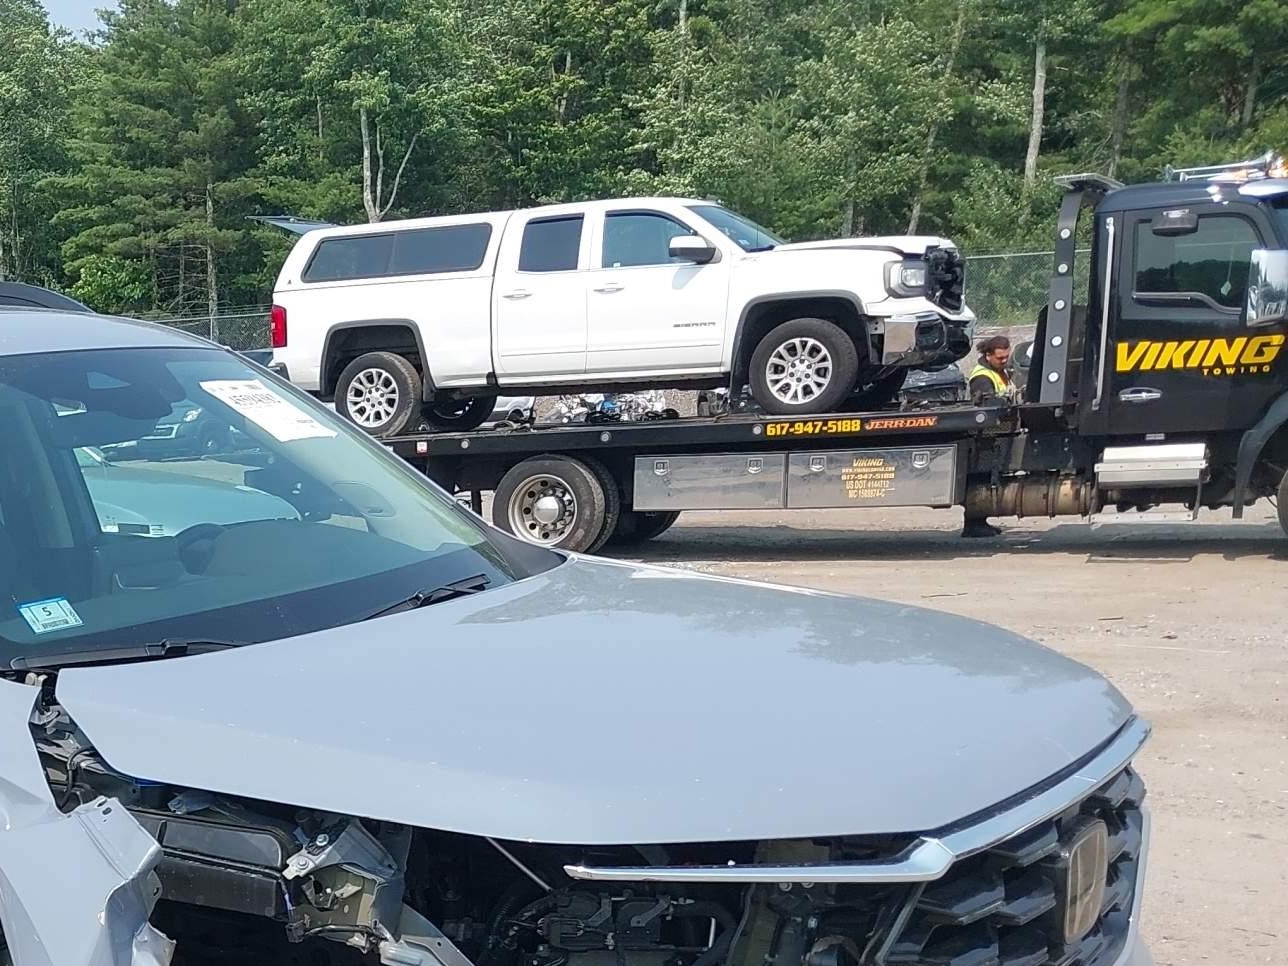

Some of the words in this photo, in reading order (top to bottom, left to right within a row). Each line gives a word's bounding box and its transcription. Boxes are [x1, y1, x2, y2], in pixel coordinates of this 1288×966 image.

[1116, 335, 1285, 372] VIKING
[1202, 365, 1271, 376] TOWING
[766, 419, 861, 436] 617-947-5188
[853, 458, 884, 467] VIKING
[41, 606, 52, 617] 5
